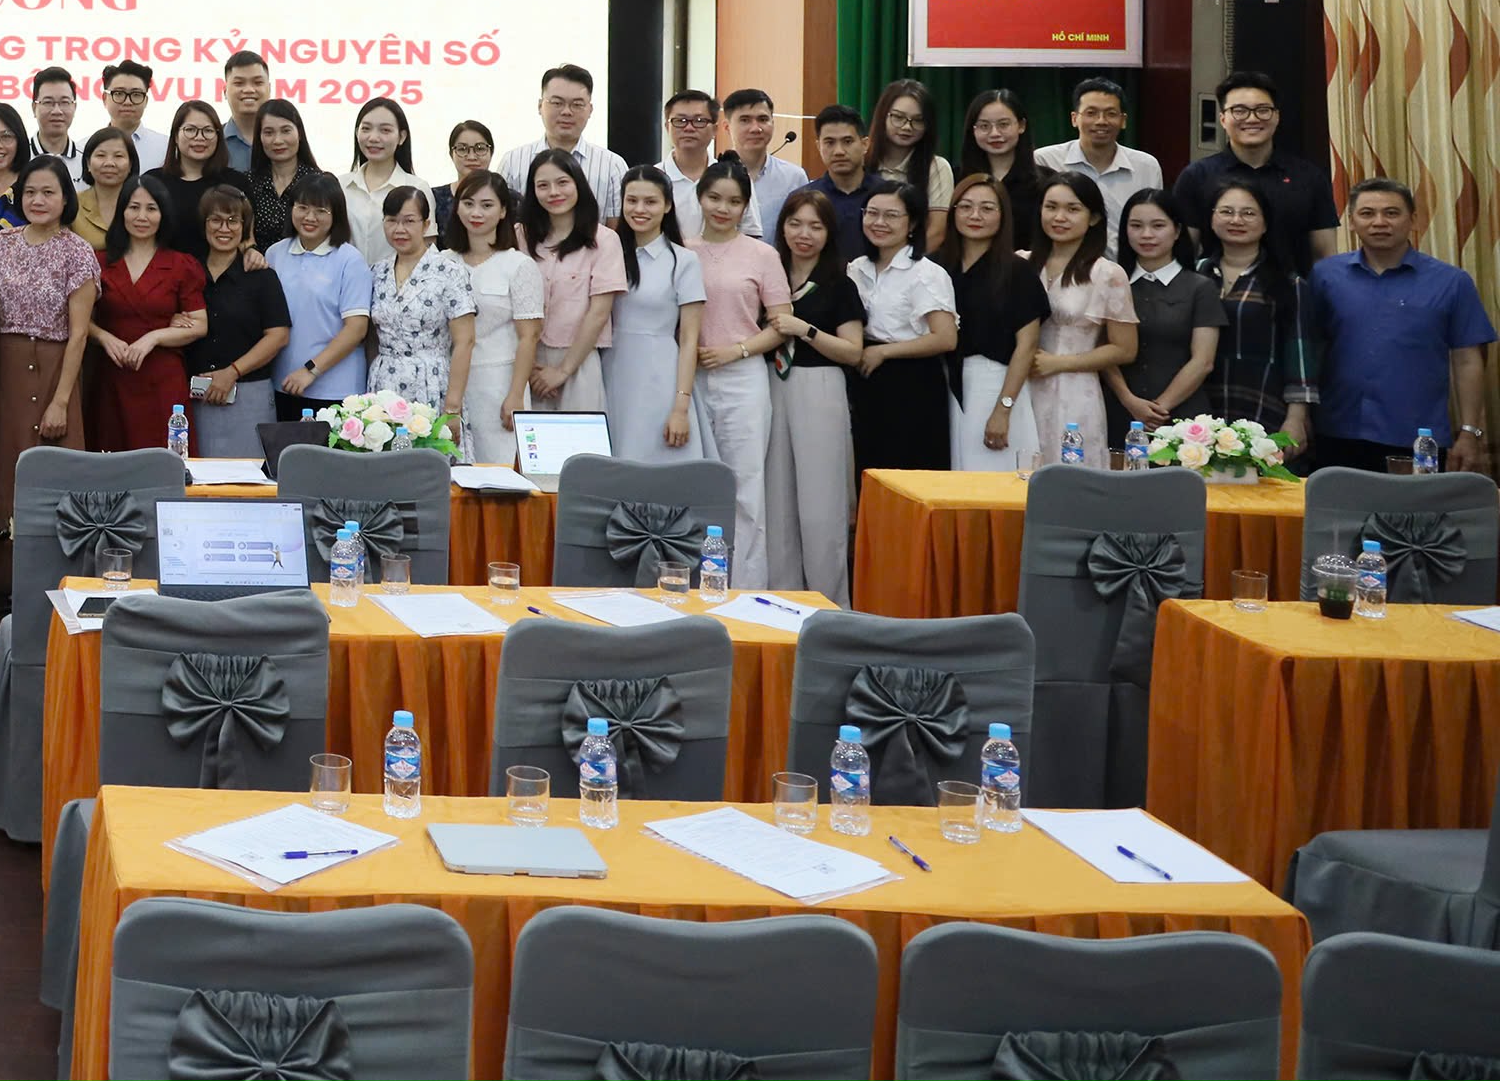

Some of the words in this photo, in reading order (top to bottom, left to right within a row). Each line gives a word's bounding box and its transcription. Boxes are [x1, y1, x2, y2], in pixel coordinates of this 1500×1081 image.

[36, 35, 182, 63] TRONG
[193, 28, 249, 63] KỶ
[260, 32, 431, 66] NGUYÊN
[443, 28, 501, 67] SỐ
[1068, 32, 1084, 41] CHÍ
[319, 78, 424, 106] 2025
